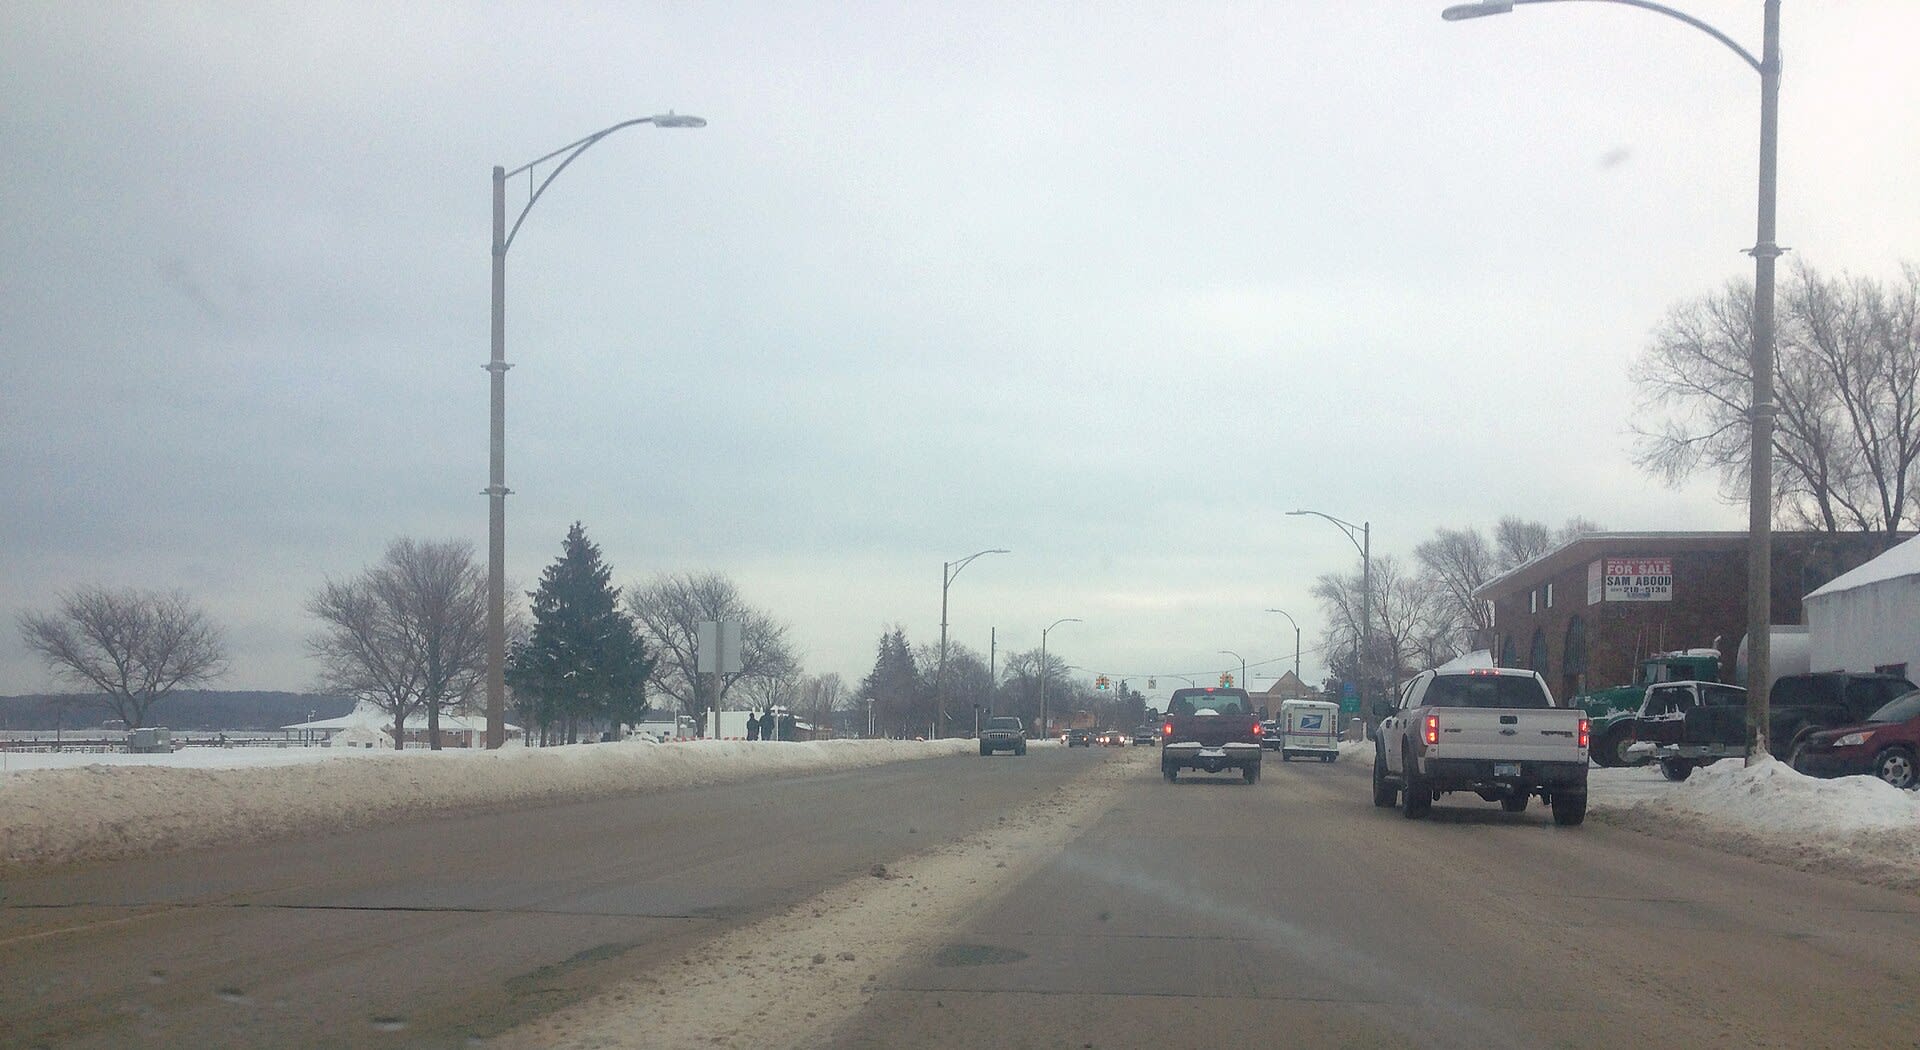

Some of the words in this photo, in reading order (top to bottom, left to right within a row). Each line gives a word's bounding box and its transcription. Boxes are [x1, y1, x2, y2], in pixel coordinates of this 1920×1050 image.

[1607, 564, 1633, 575] FOR
[1639, 564, 1671, 575] SALE
[1607, 576, 1631, 586] SAM
[1635, 576, 1671, 586] ABOOD
